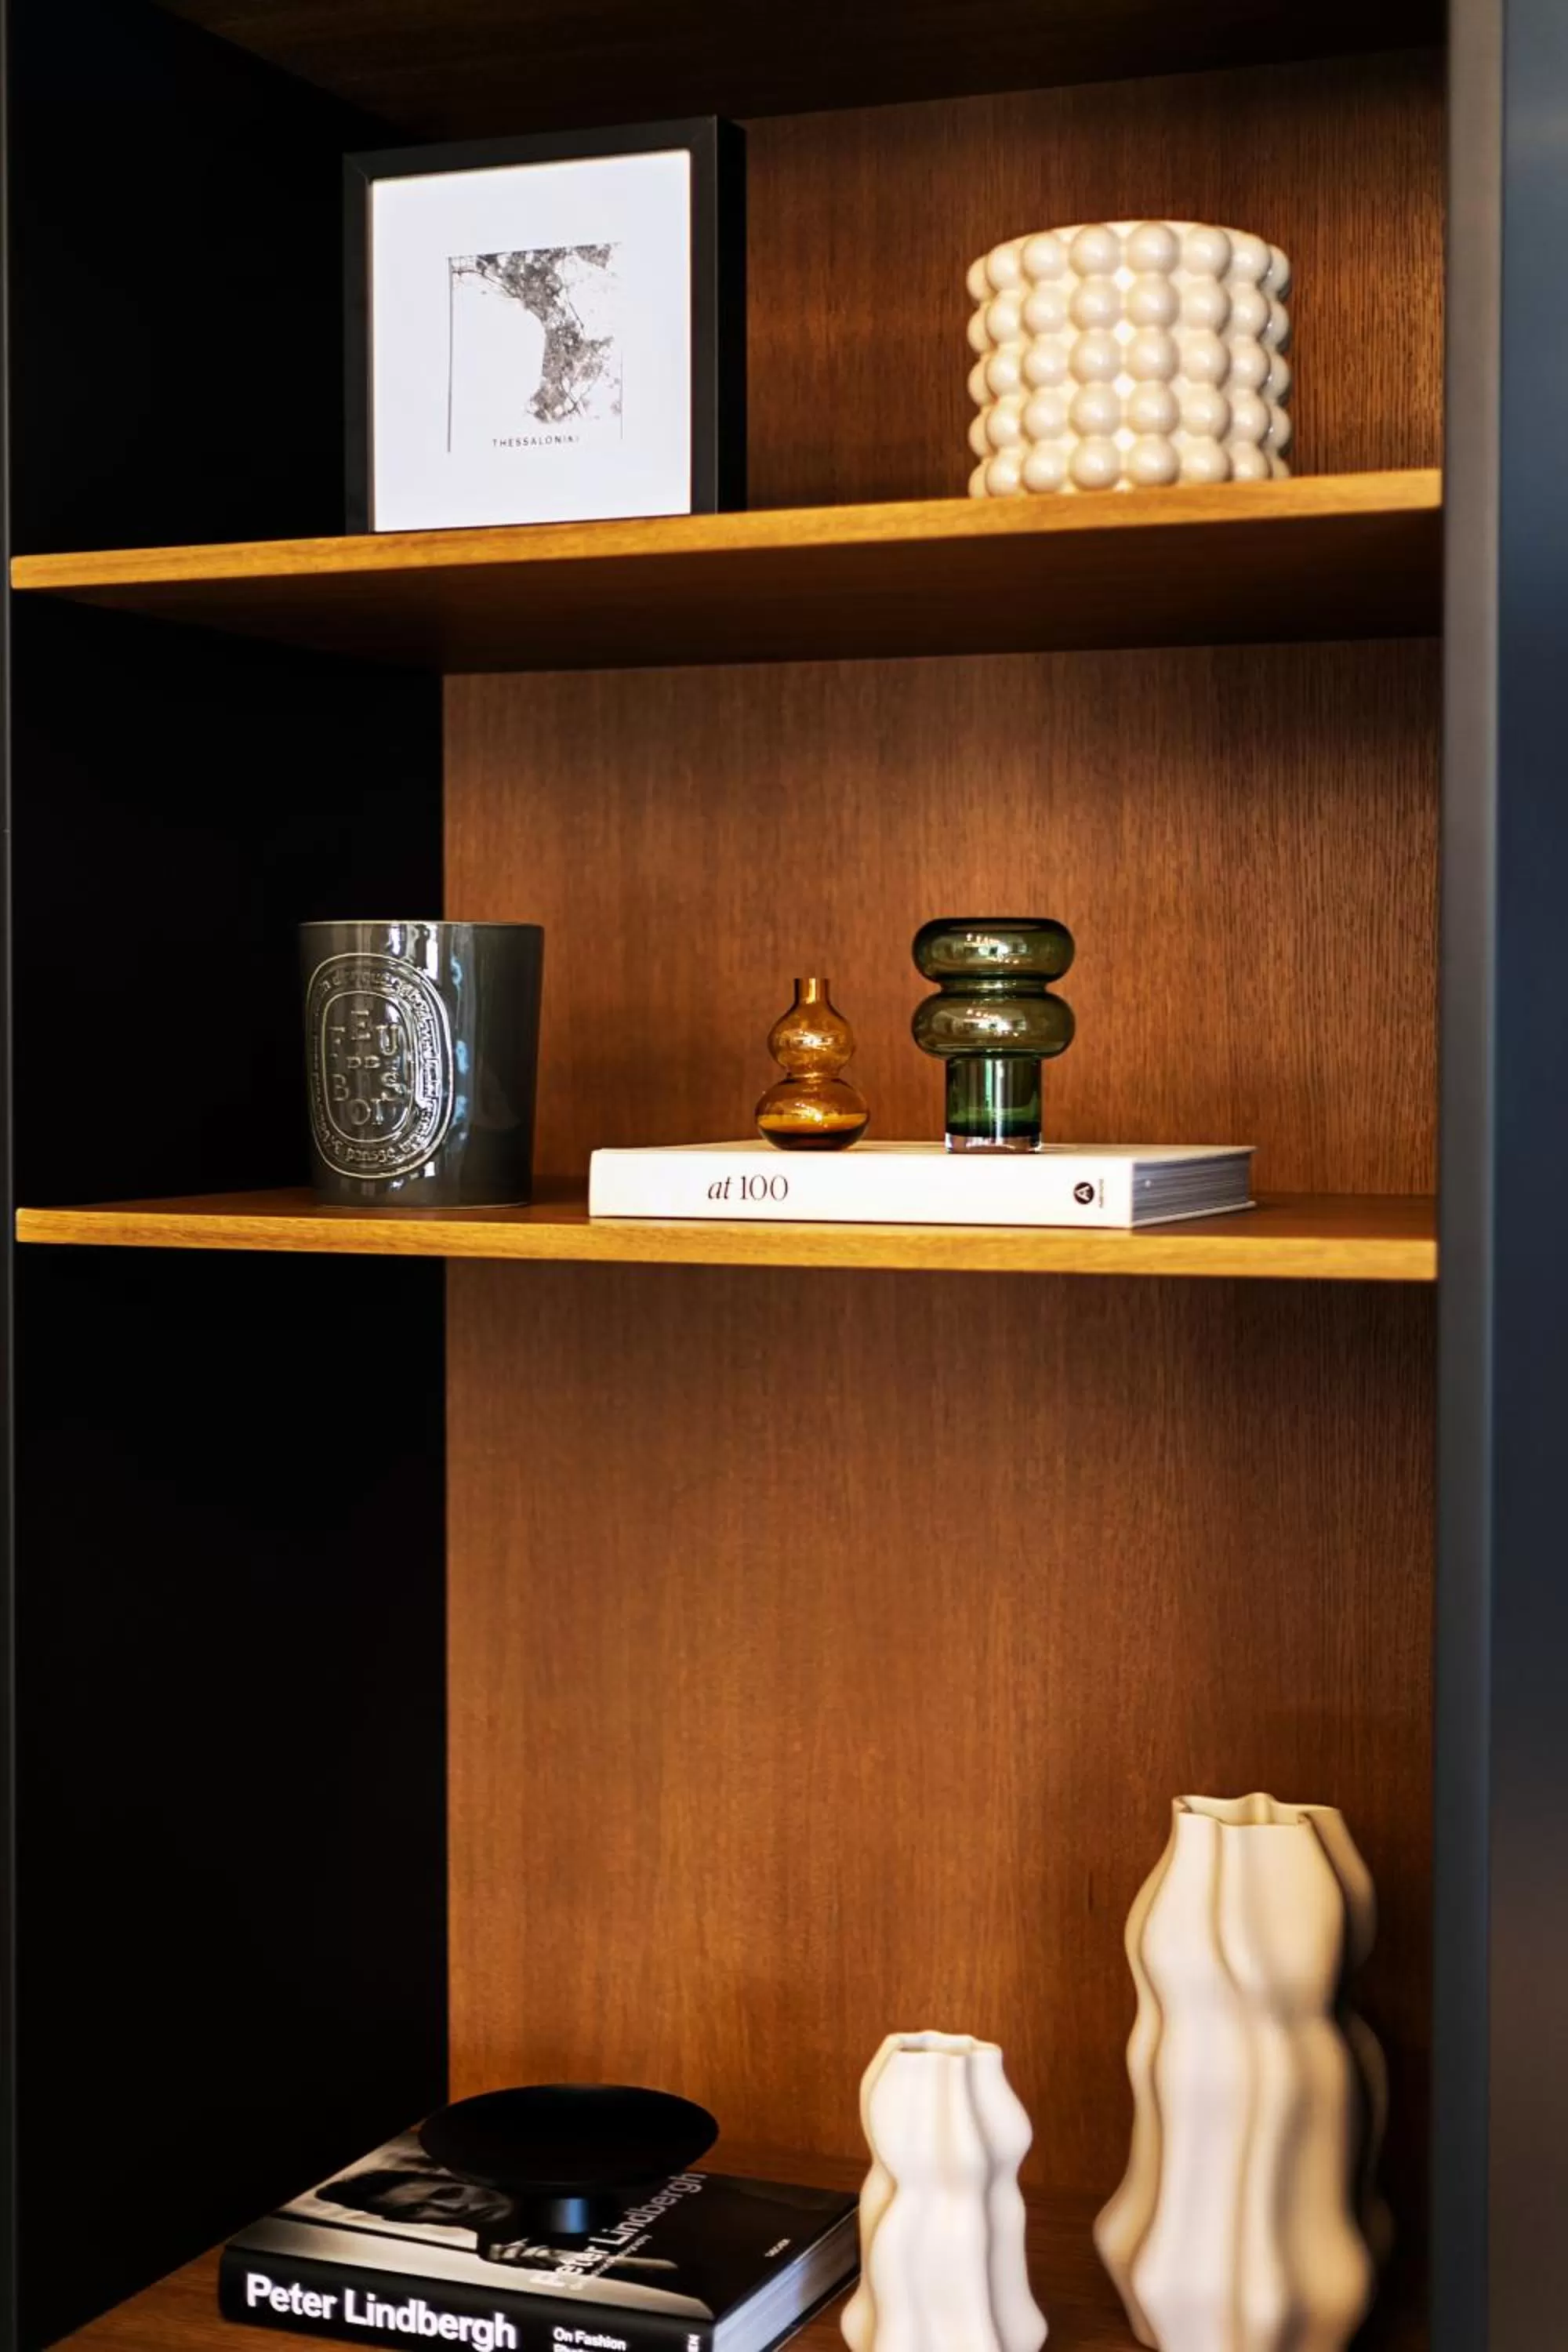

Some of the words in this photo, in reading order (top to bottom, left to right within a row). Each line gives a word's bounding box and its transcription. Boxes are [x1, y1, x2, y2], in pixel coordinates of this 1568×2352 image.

[707, 1175, 733, 1200] at
[739, 1174, 789, 1201] 100
[588, 2172, 707, 2245] Lindbergh
[245, 2272, 338, 2320] Peter
[343, 2288, 517, 2352] Lindbergh
[553, 2326, 573, 2343] On
[574, 2329, 627, 2351] Fashion
